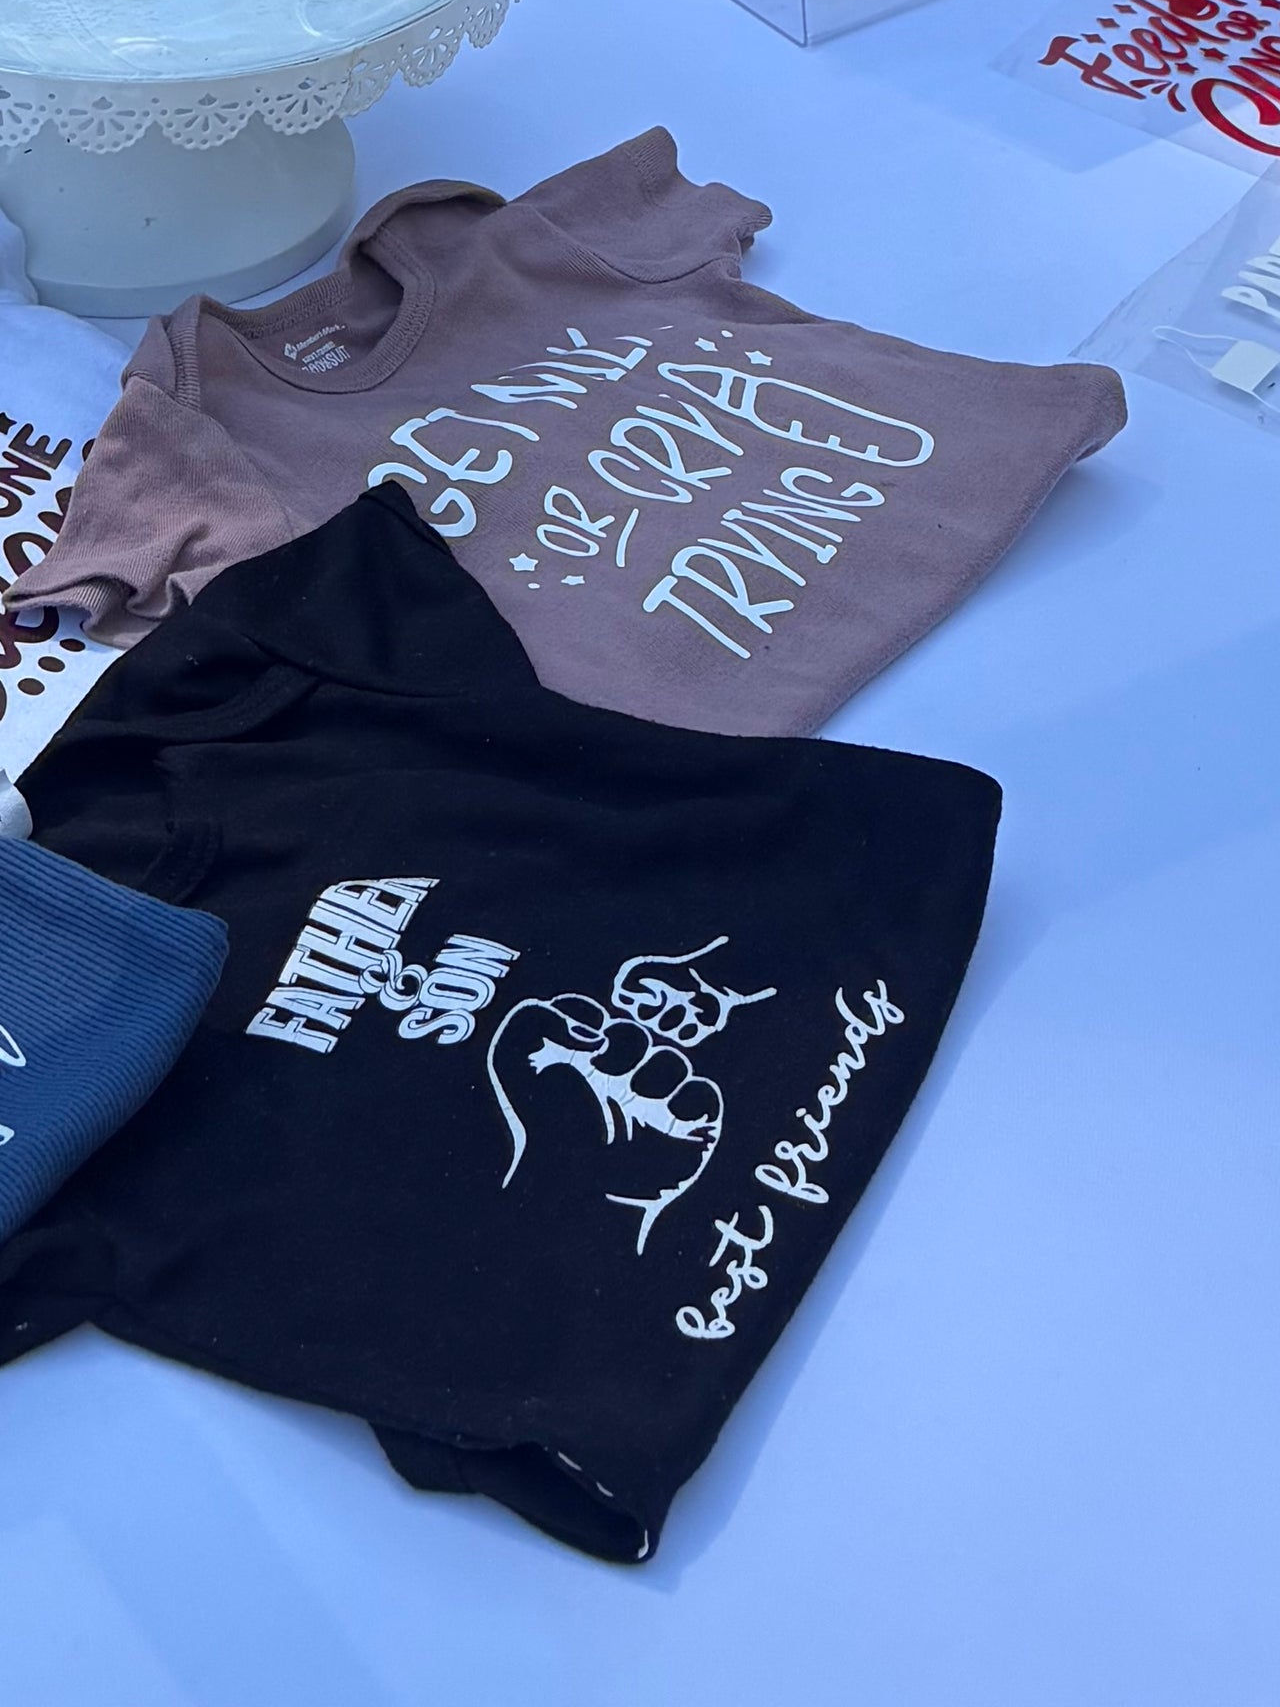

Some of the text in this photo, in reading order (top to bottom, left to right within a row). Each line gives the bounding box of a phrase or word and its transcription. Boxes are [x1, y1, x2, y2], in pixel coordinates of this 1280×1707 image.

[535, 393, 745, 558] OR CRY
[641, 466, 886, 660] TRYING
[357, 949, 429, 1012] &
[397, 933, 521, 1045] SON
[675, 978, 906, 1340] best friends
